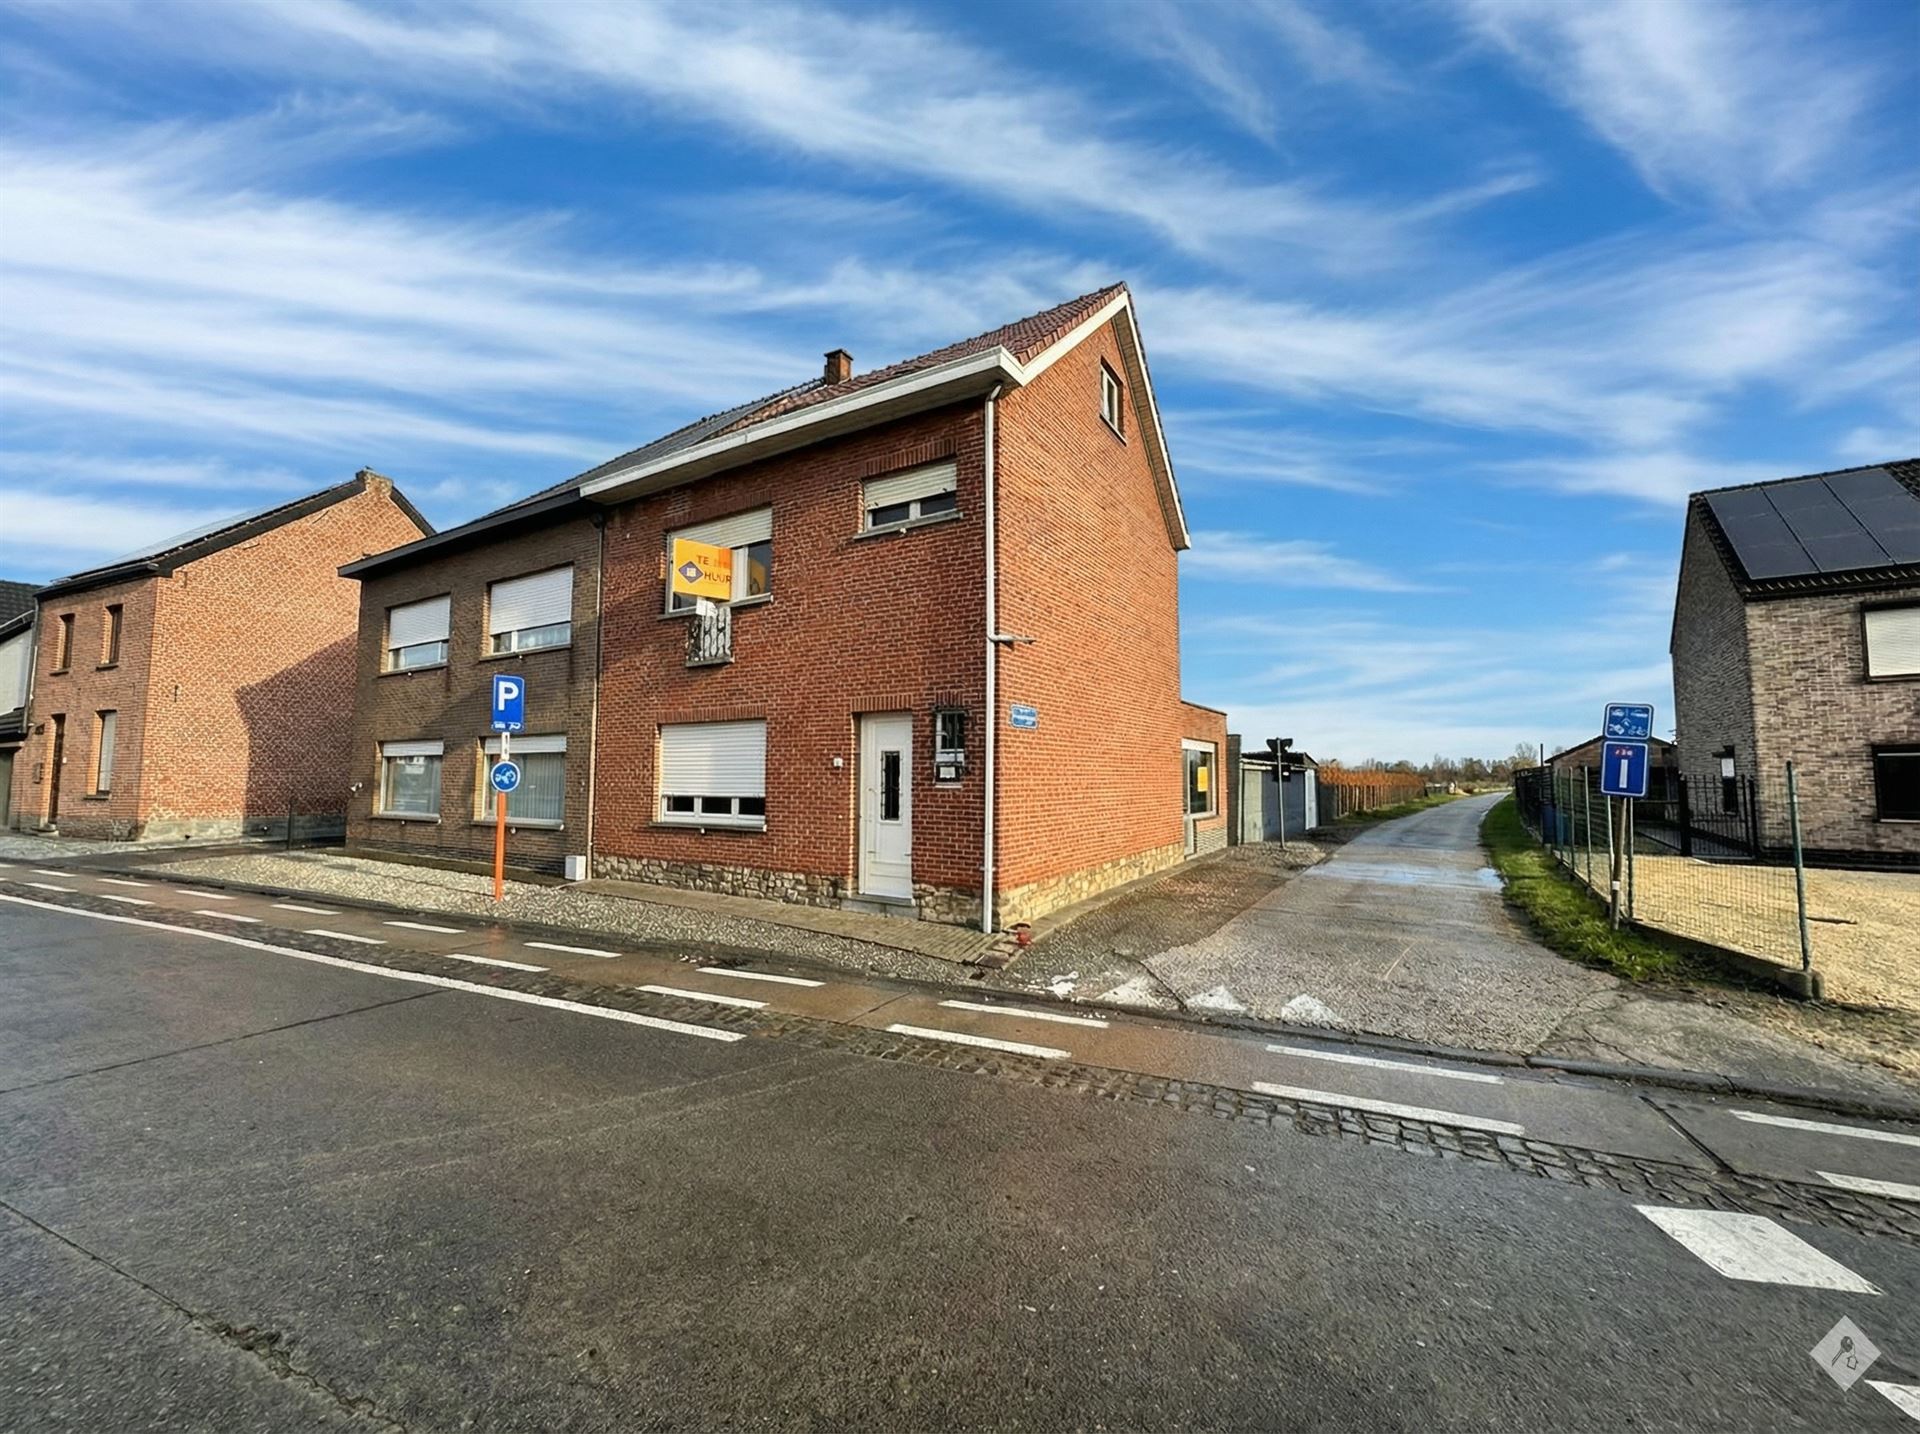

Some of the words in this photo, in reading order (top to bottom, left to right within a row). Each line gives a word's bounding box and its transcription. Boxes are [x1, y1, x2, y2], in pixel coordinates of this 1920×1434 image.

[696, 555, 709, 565] TE
[704, 571, 731, 584] HUUR
[498, 681, 519, 711] P
